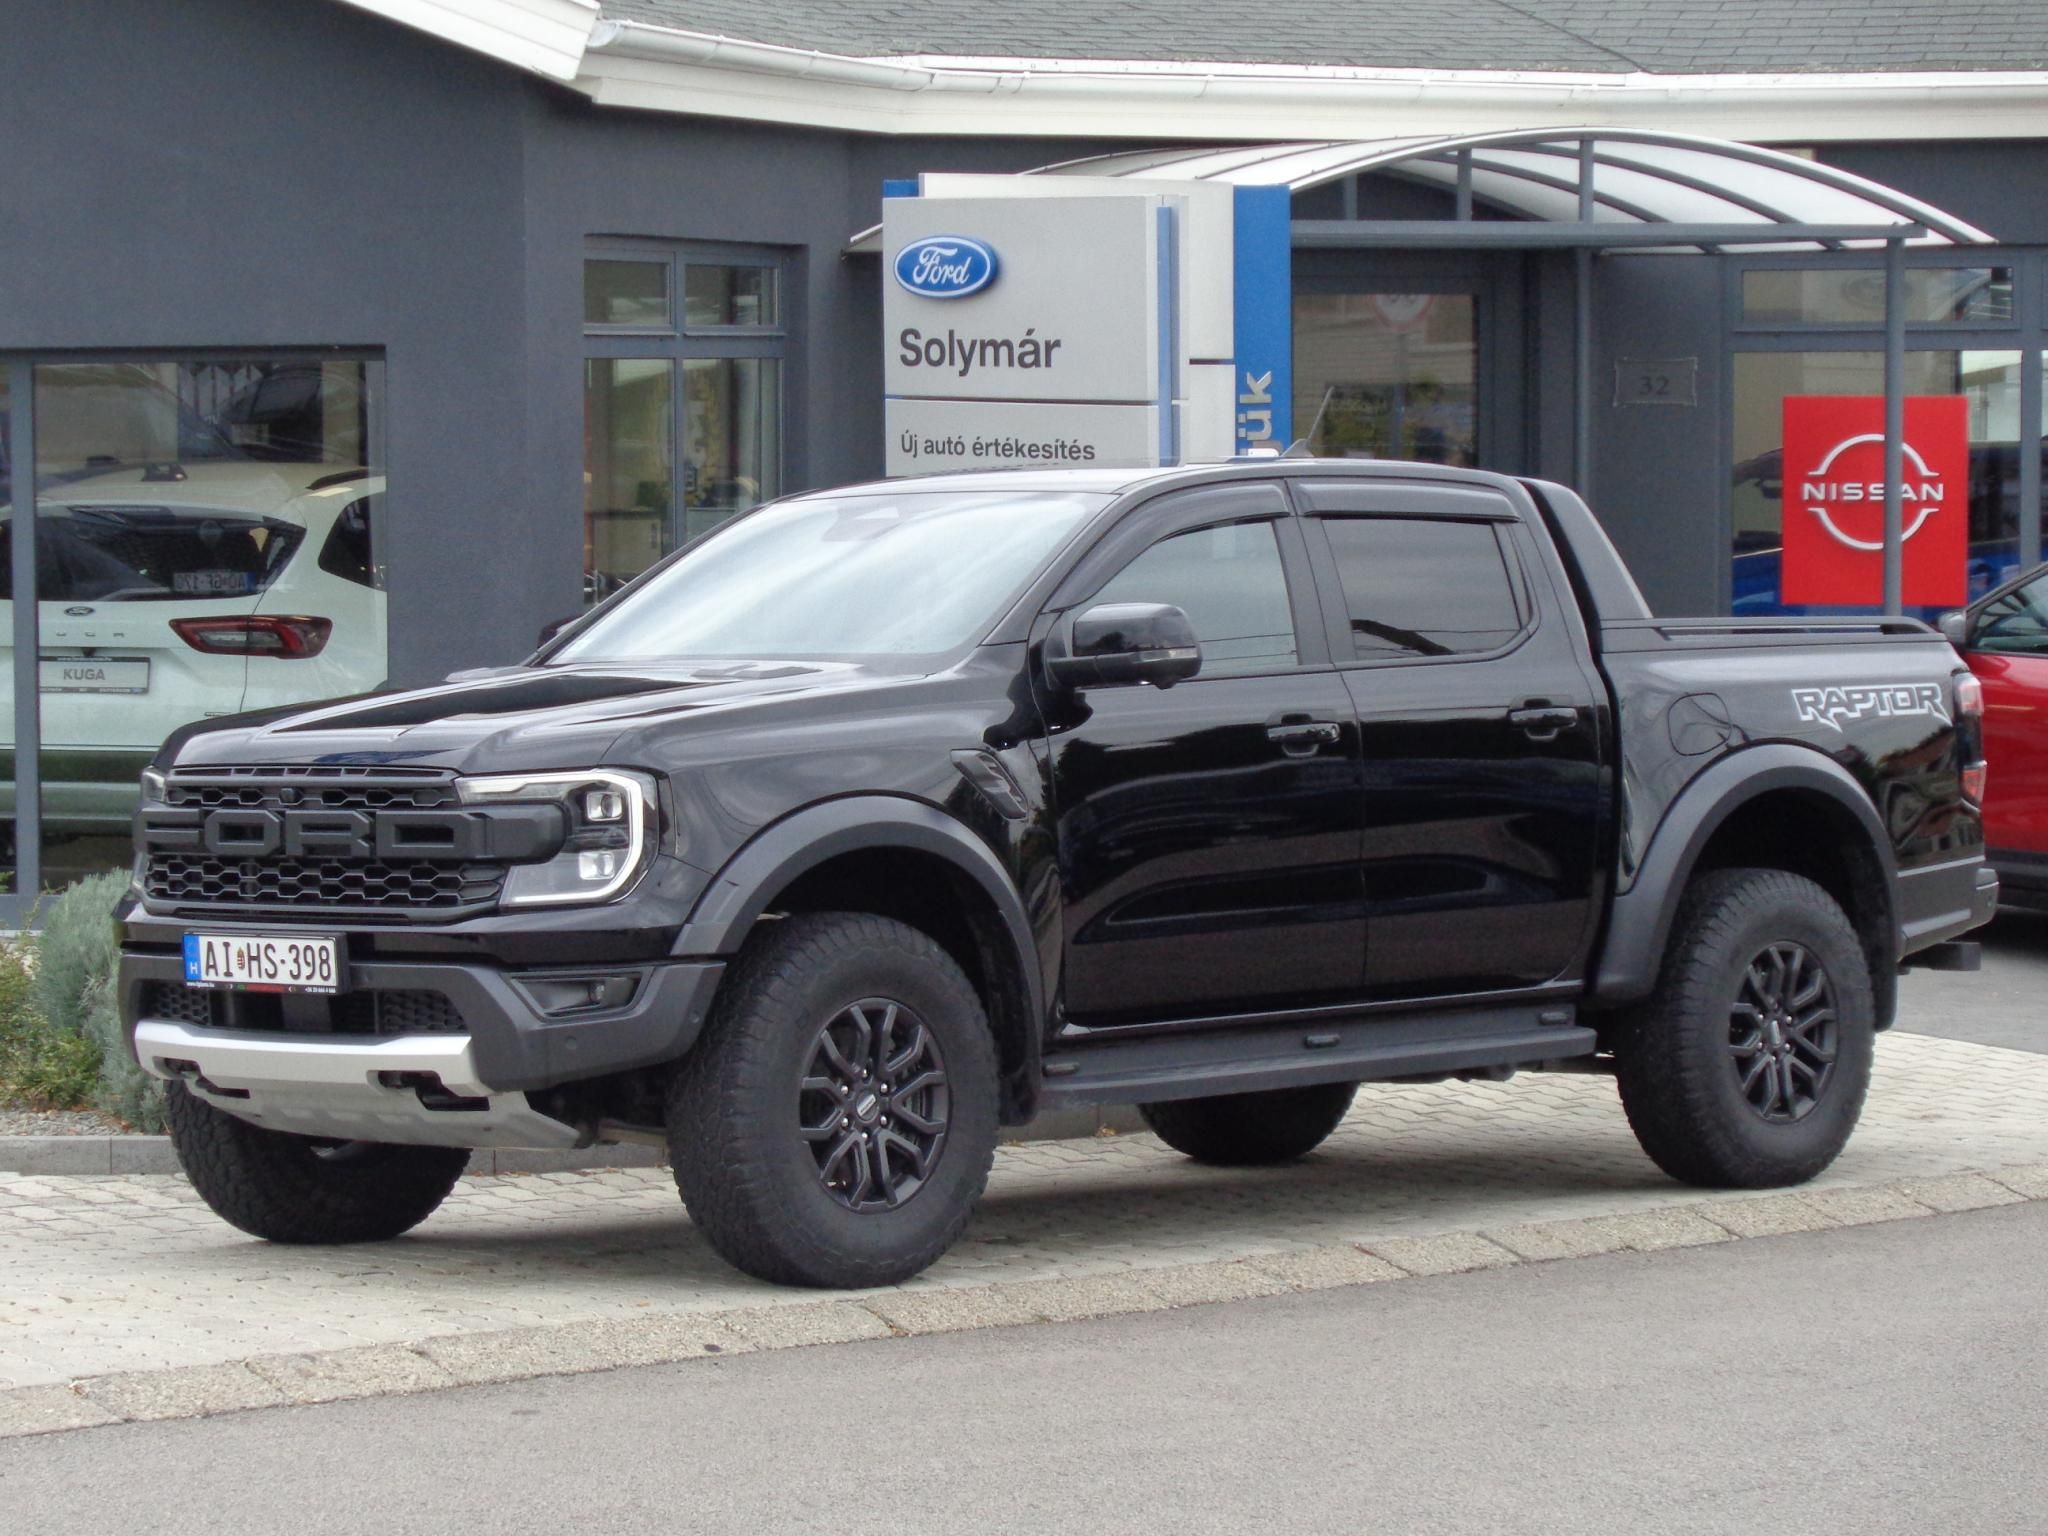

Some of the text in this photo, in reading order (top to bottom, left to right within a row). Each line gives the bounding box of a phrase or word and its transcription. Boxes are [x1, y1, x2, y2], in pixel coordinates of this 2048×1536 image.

[912, 246, 970, 286] Ford
[899, 328, 1061, 377] Solymár
[901, 430, 1096, 461] Új autó értékesítés
[1802, 482, 1944, 502] NISSAN
[63, 668, 105, 680] KUGA
[1792, 683, 1953, 734] RAPTOR
[136, 807, 475, 860] FORD
[189, 963, 198, 974] H
